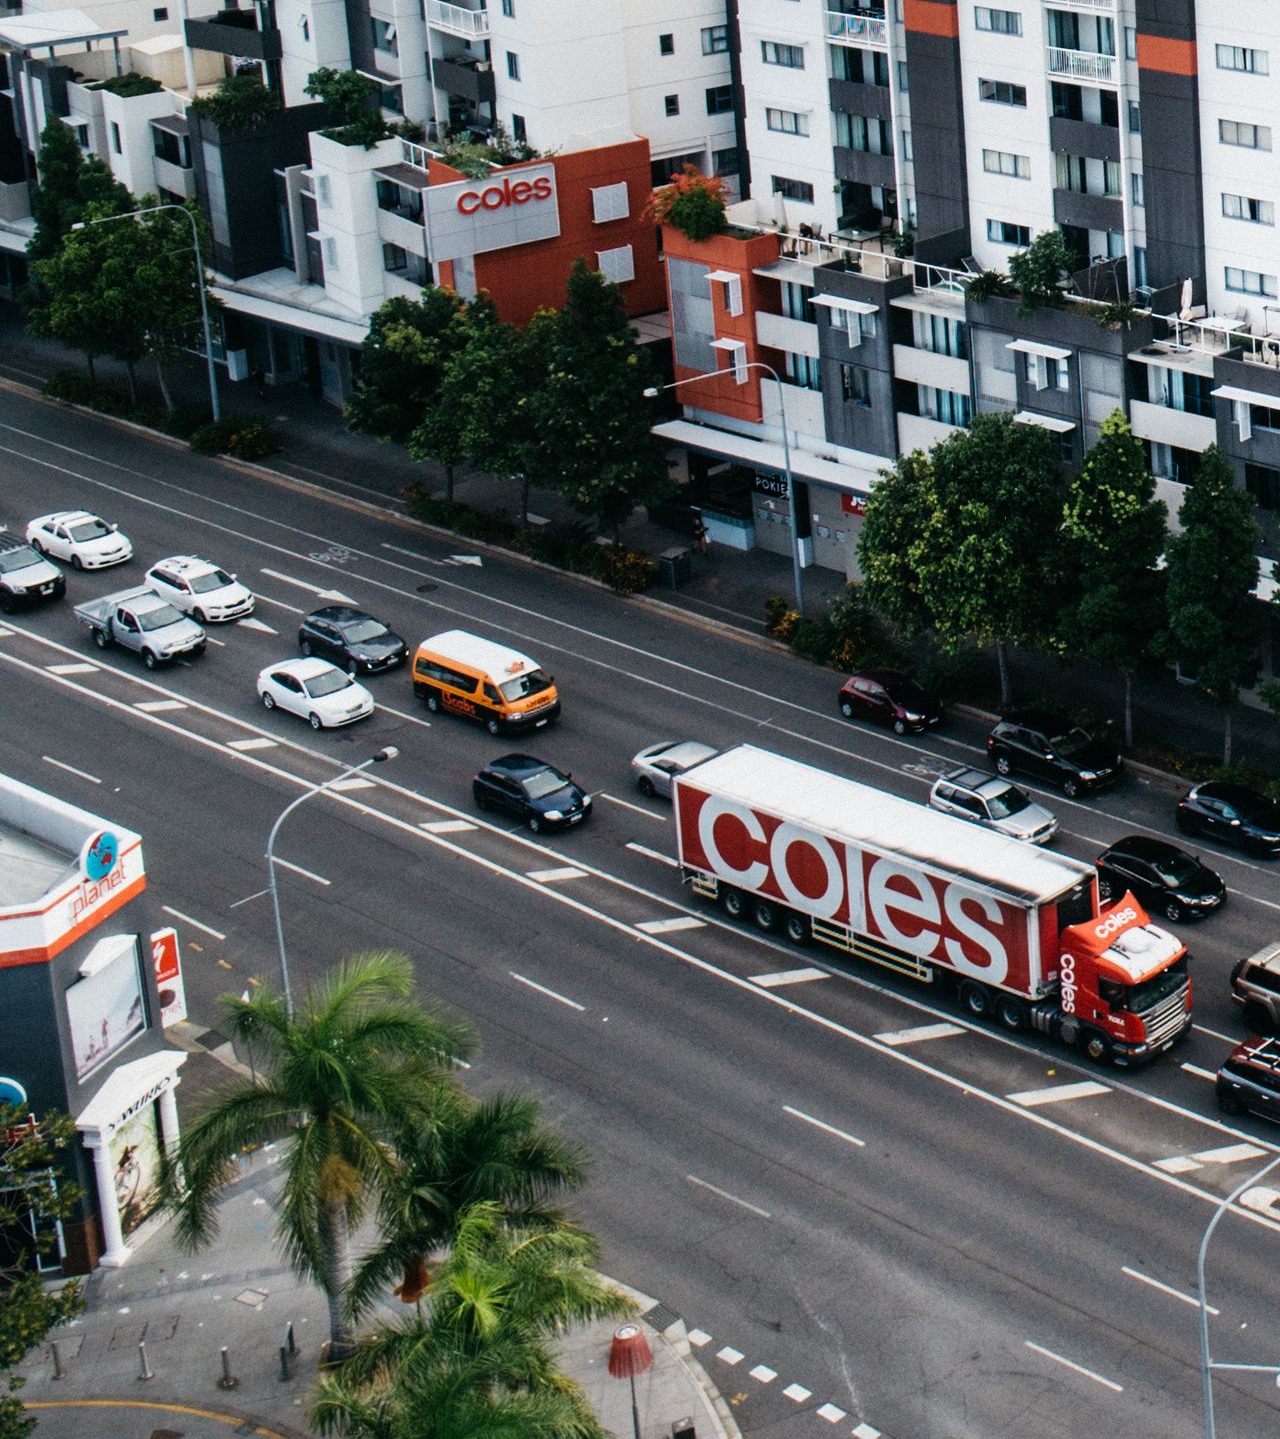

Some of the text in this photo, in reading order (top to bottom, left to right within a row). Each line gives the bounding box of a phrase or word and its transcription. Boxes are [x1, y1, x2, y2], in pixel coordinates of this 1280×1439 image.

[456, 176, 552, 216] coles
[71, 860, 128, 925] planet
[698, 795, 1009, 989] coles
[1094, 907, 1137, 938] coles
[1060, 953, 1078, 1014] coles
